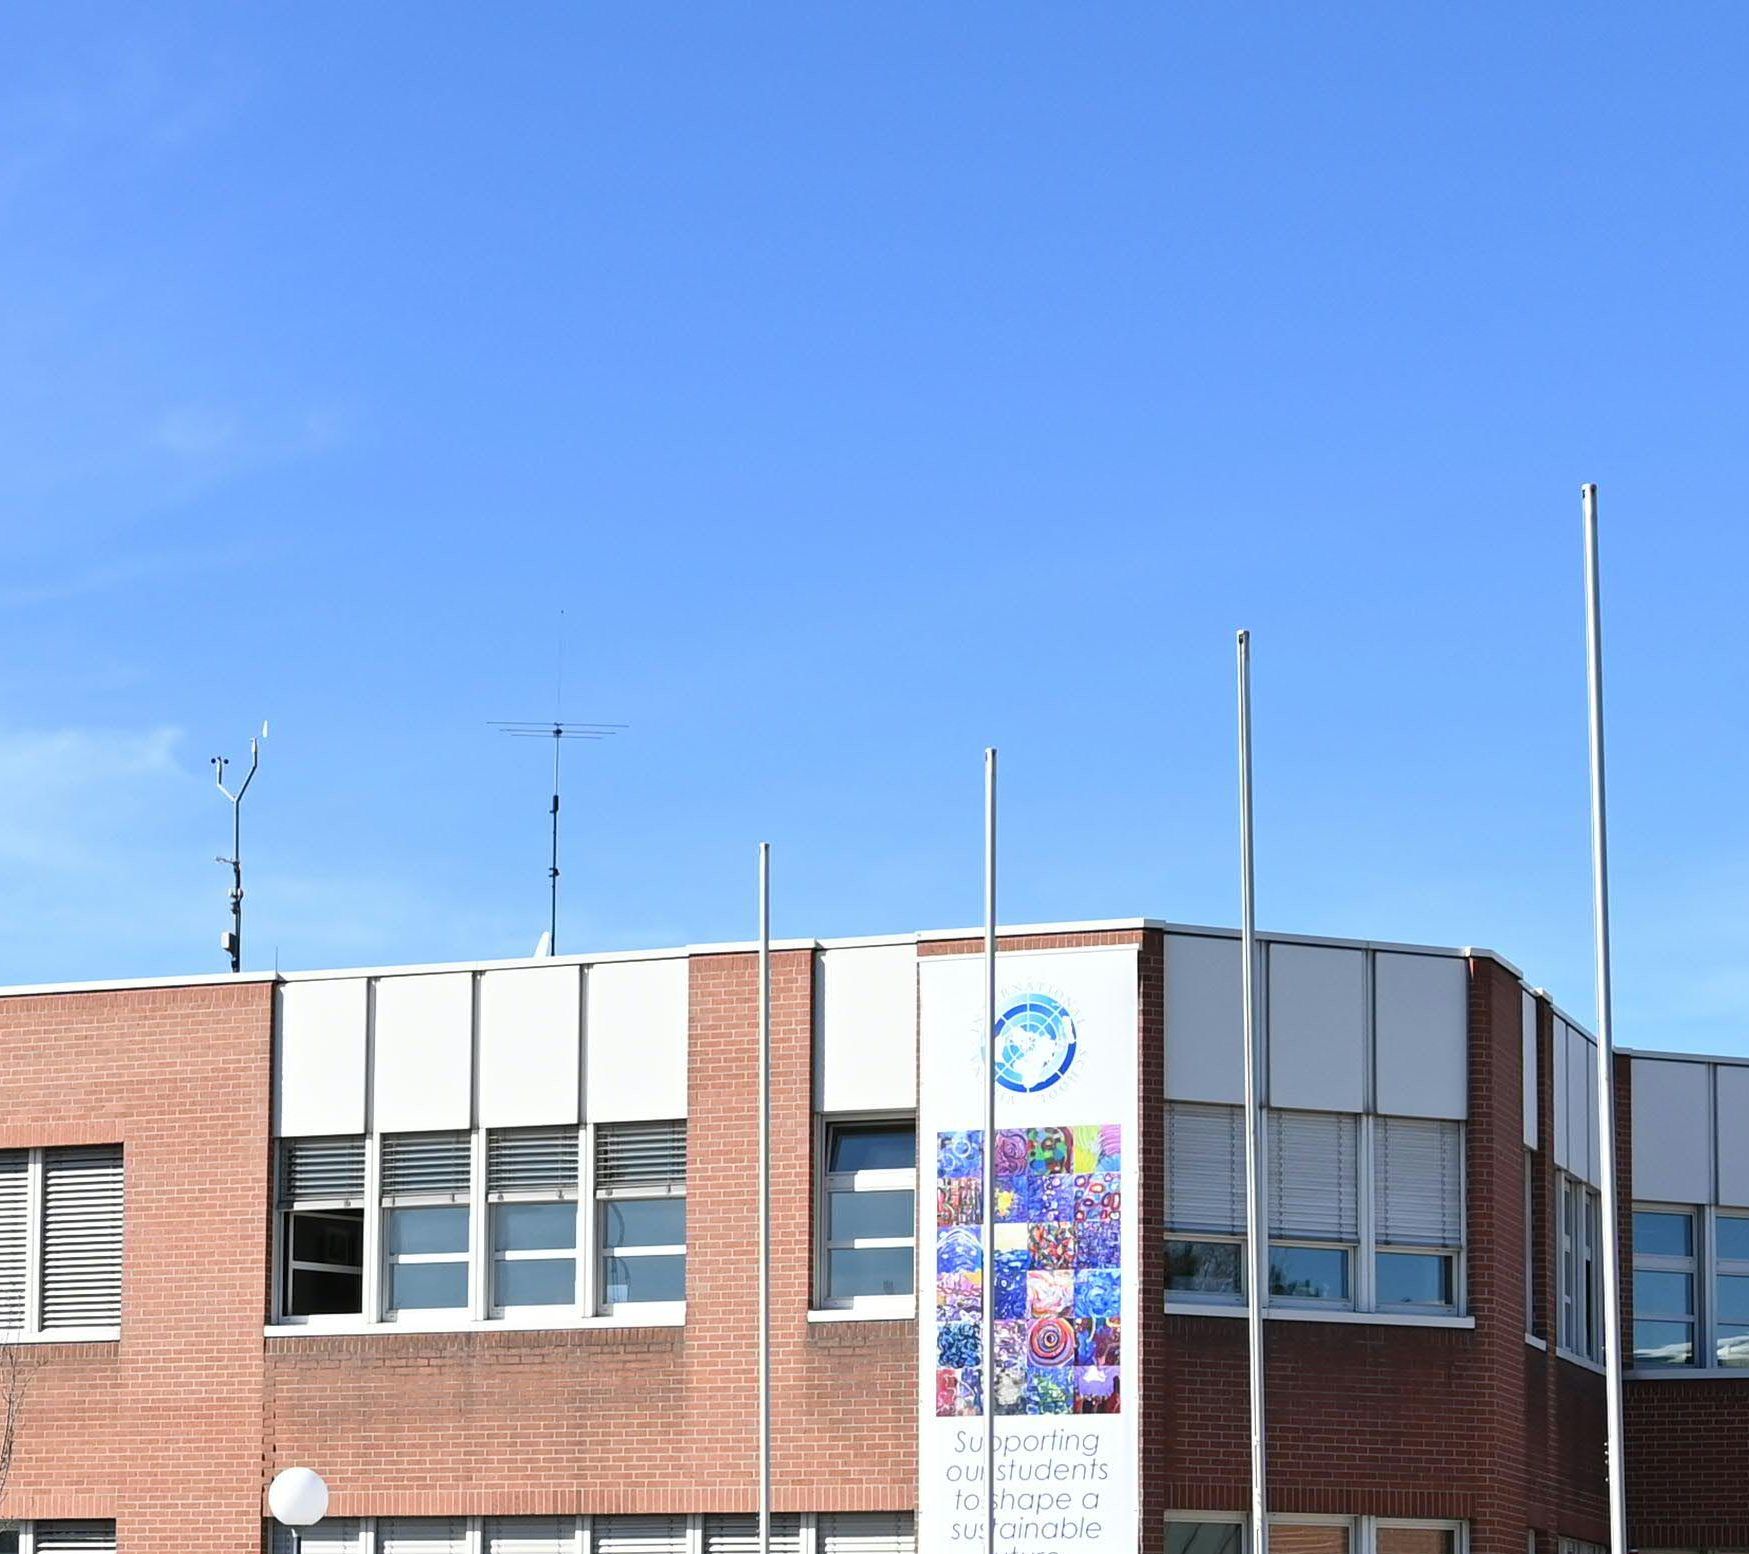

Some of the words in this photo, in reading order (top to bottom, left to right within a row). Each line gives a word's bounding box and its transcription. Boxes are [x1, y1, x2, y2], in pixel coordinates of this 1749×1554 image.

[996, 1458, 1109, 1481] students
[955, 1489, 980, 1511] to
[1082, 1492, 1100, 1511] a
